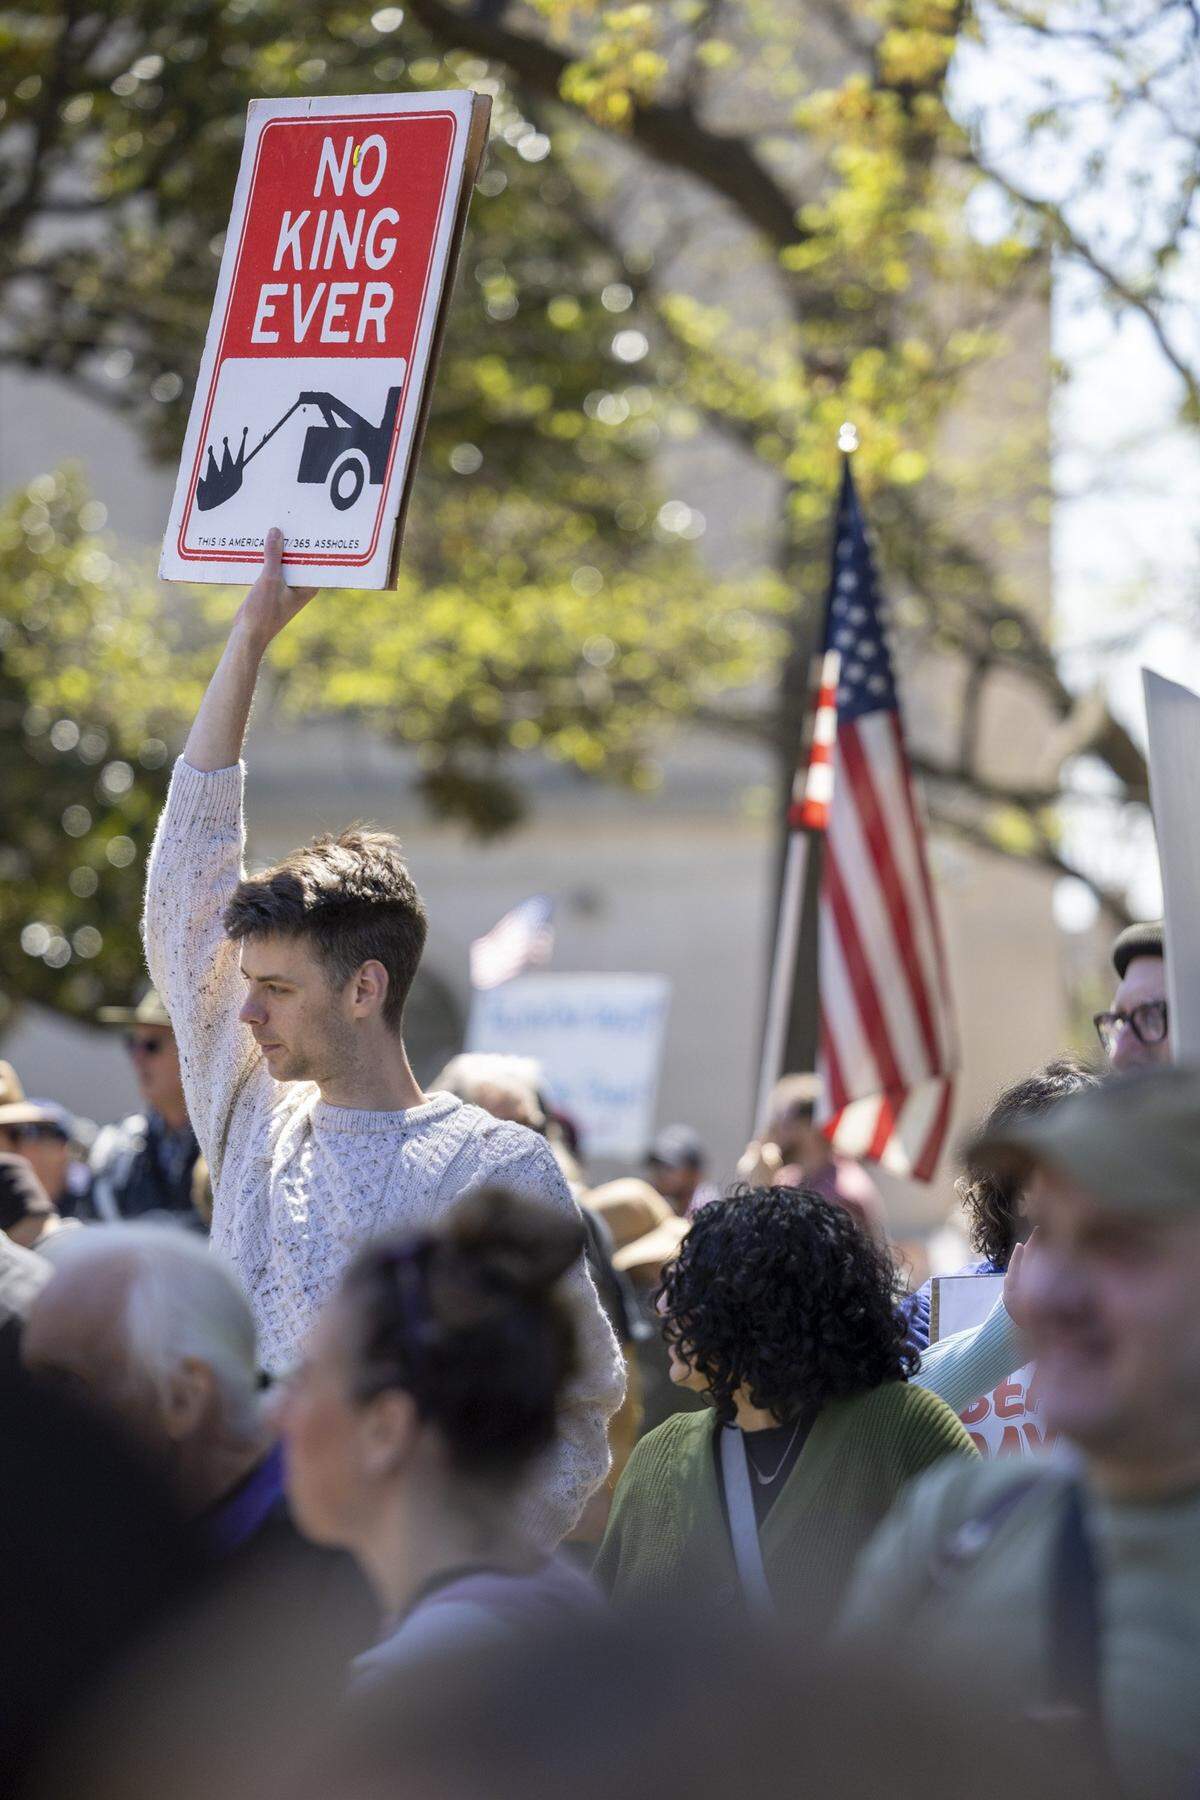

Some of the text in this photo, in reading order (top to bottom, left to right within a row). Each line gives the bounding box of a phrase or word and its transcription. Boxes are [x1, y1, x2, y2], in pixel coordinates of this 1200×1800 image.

[313, 134, 388, 198] NO
[272, 207, 400, 272] KING
[250, 281, 395, 344] EVER
[198, 536, 216, 547] THIS
[218, 537, 227, 547] IS
[228, 537, 264, 548] AMERICA
[314, 539, 360, 549] ASSHOLES
